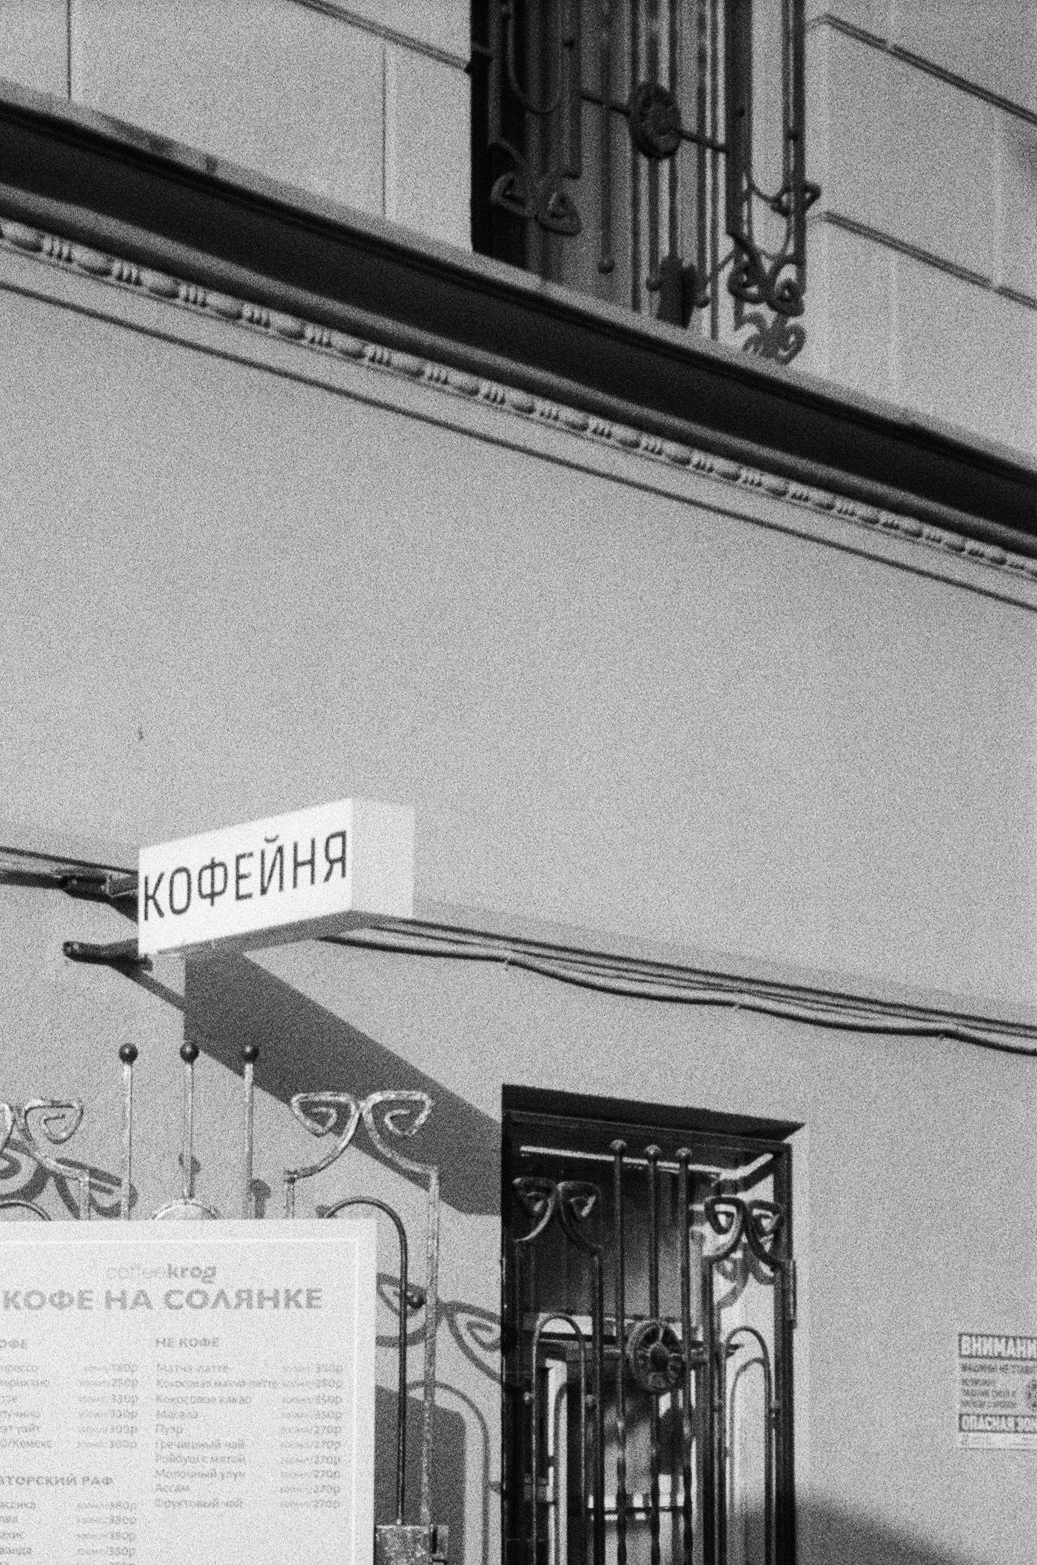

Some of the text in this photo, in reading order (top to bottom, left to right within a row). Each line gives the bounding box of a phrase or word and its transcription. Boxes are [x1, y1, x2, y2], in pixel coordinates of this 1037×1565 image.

[144, 830, 346, 921] КОФЕЙНЯ
[3, 1288, 323, 1311] КОФЕ НА СОЛЯНКЕ
[155, 1337, 220, 1348] НЕ КОФЕ
[81, 1476, 114, 1486] РАФ
